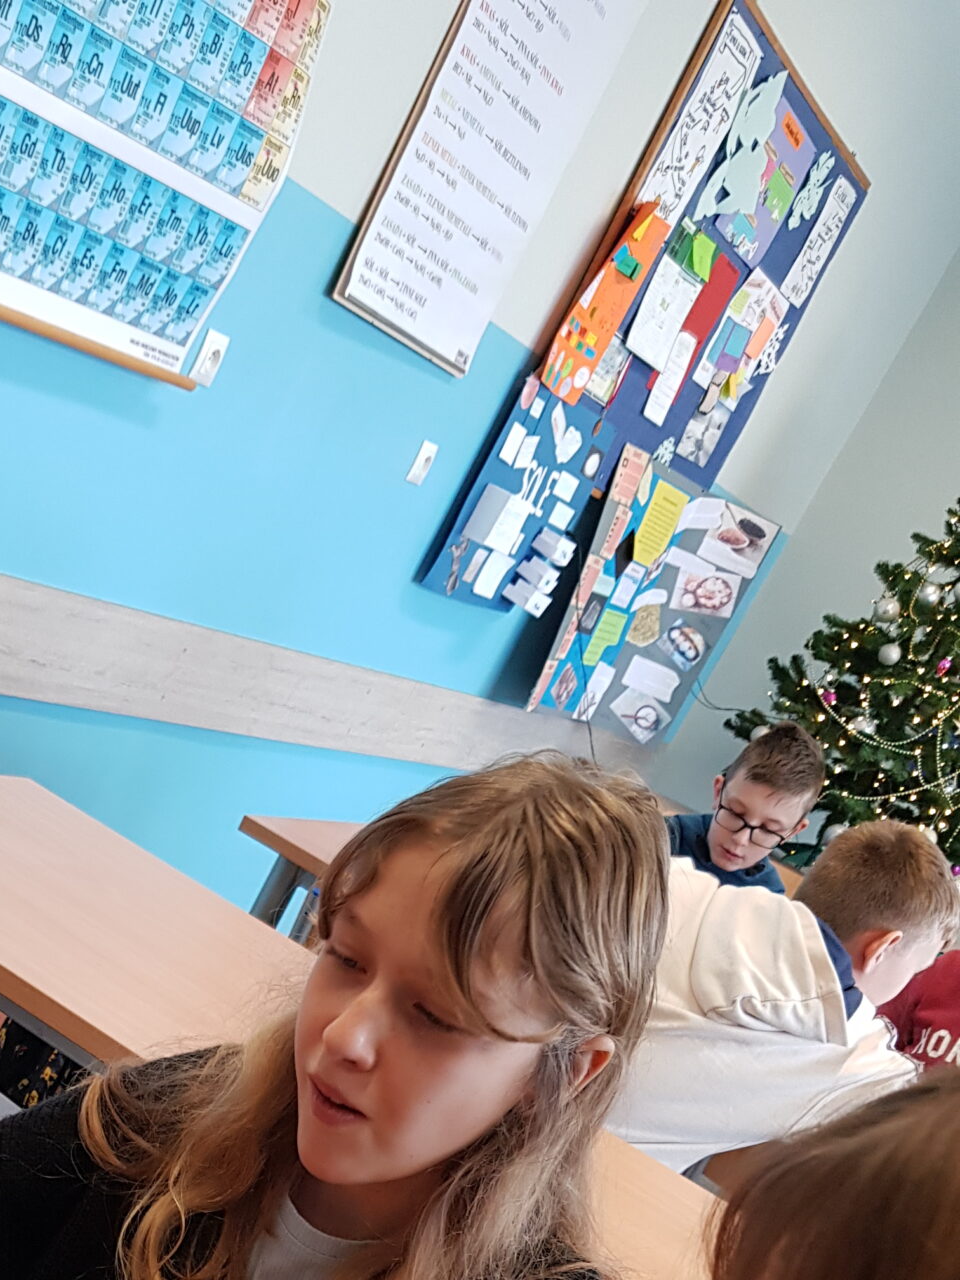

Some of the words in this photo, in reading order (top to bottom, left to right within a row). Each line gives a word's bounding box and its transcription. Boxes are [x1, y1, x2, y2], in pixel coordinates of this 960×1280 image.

[26, 14, 43, 42] Ds
[178, 13, 195, 40] Pb
[57, 33, 73, 64] Rg
[209, 33, 223, 58] Bi
[88, 53, 104, 80] Cn
[238, 51, 253, 76] Po
[120, 72, 141, 101] Uut
[179, 107, 201, 140] Uup
[20, 132, 38, 159] Gd
[210, 126, 225, 150] Lv
[50, 147, 66, 173] Tb
[235, 141, 255, 168] Uus
[80, 164, 97, 192] Dy
[108, 179, 127, 203] Ho
[137, 195, 151, 216] Er
[166, 209, 182, 232] Tm
[22, 221, 39, 247] Bk
[193, 224, 209, 246] Yb
[80, 248, 95, 270] Es
[109, 261, 128, 285] Fm
[137, 273, 157, 297] Md
[162, 286, 178, 307] No
